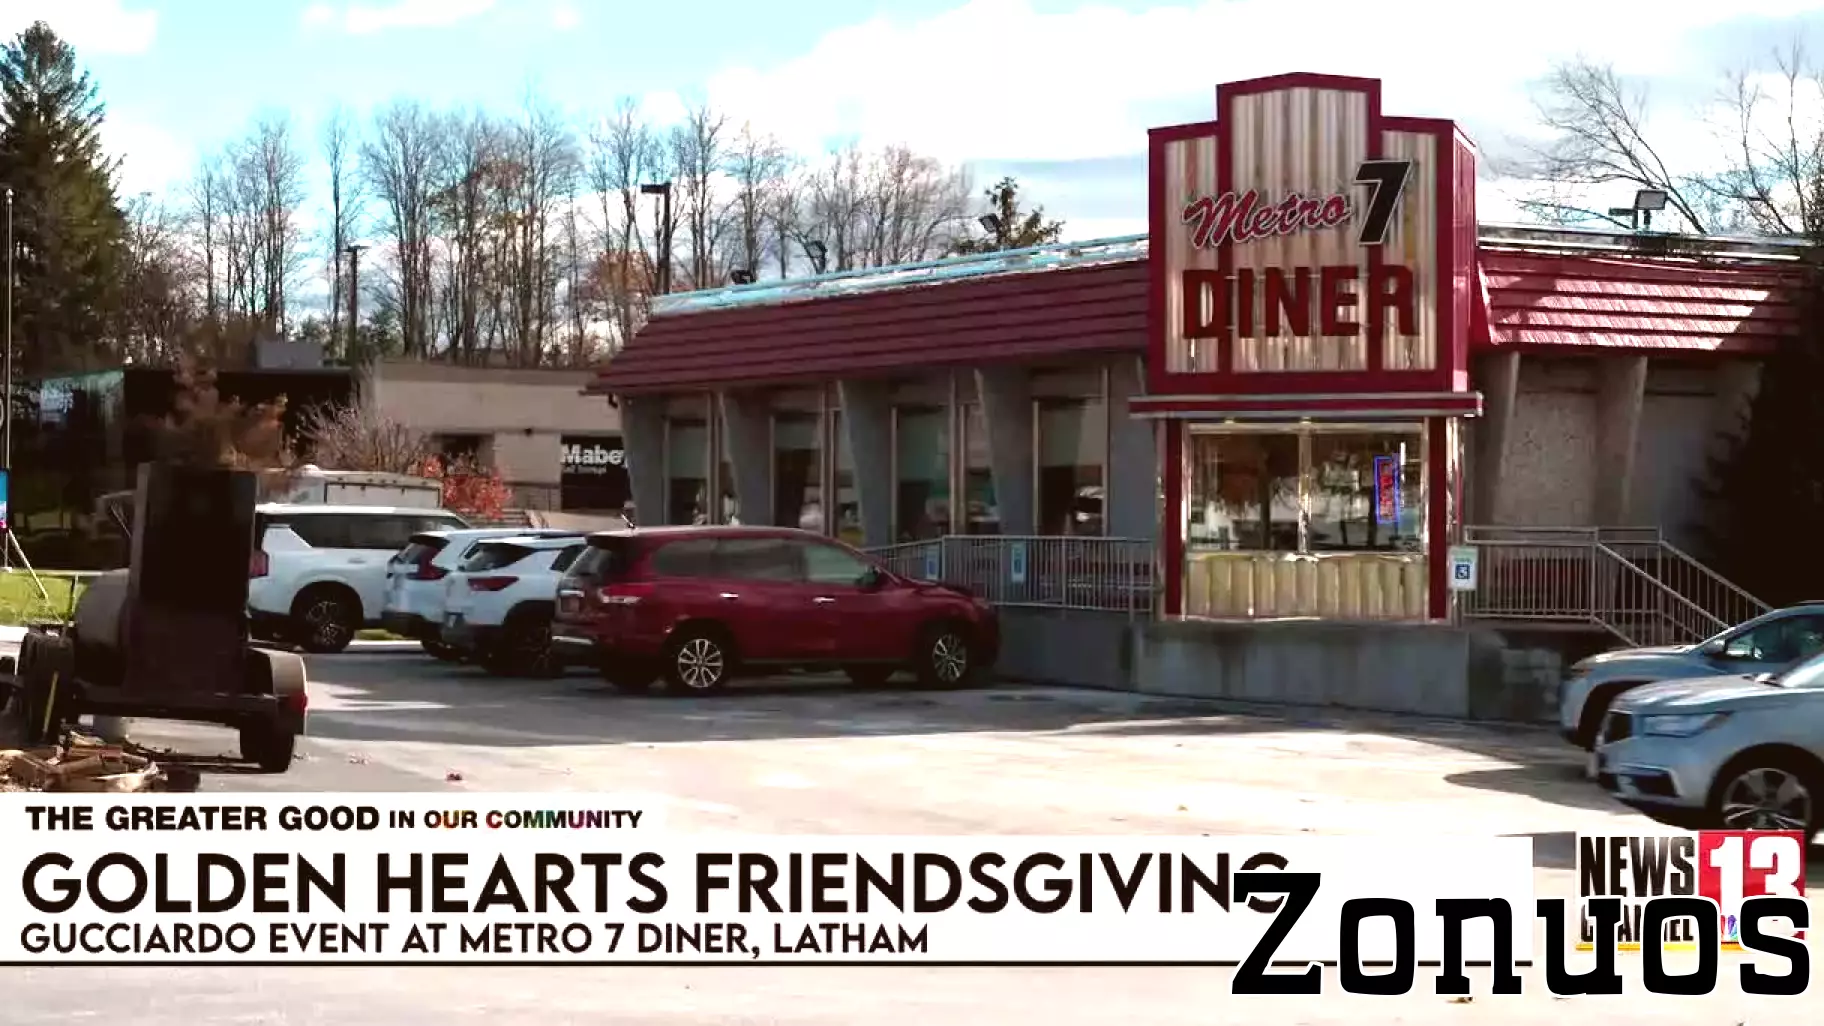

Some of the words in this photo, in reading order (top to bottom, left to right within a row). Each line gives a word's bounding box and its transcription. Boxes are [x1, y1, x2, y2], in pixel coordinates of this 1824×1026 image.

[1182, 189, 1352, 249] Metro
[1353, 158, 1415, 247] 7
[1182, 265, 1419, 339] DINER
